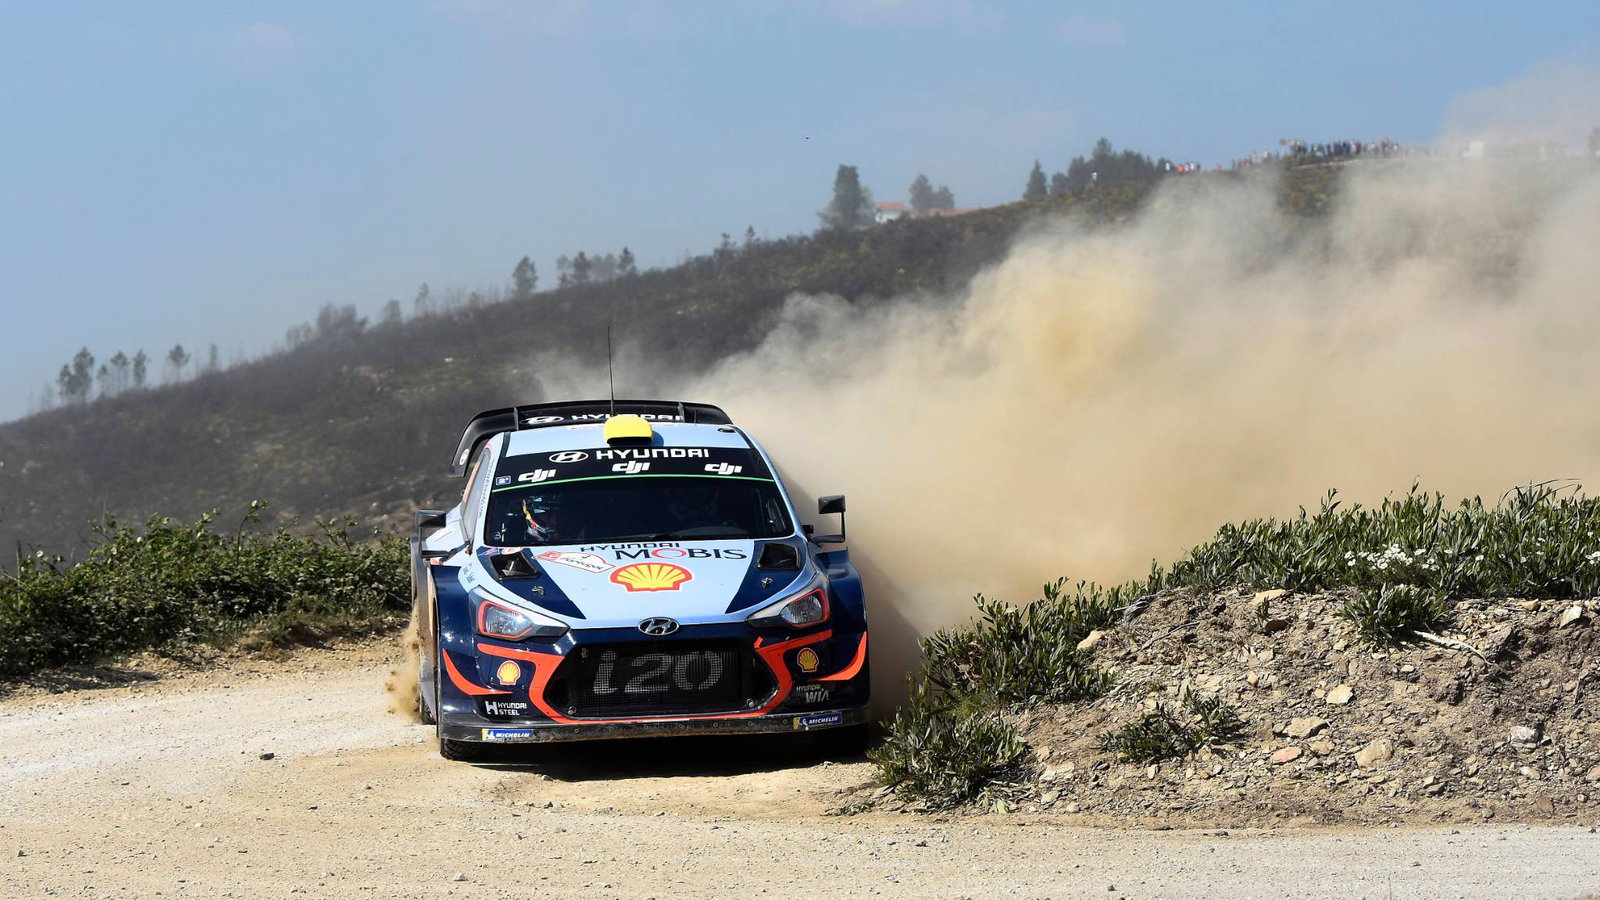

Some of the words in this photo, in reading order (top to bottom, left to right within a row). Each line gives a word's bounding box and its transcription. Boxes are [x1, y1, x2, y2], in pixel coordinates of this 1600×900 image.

[571, 413, 682, 421] HYDAI
[596, 449, 709, 460] HYUNDAI
[580, 543, 680, 552] HYUNDAI
[615, 548, 747, 560] MOBIS
[593, 650, 723, 695] i20
[796, 684, 821, 692] HYUNDAI
[808, 716, 839, 724] MICHELIN
